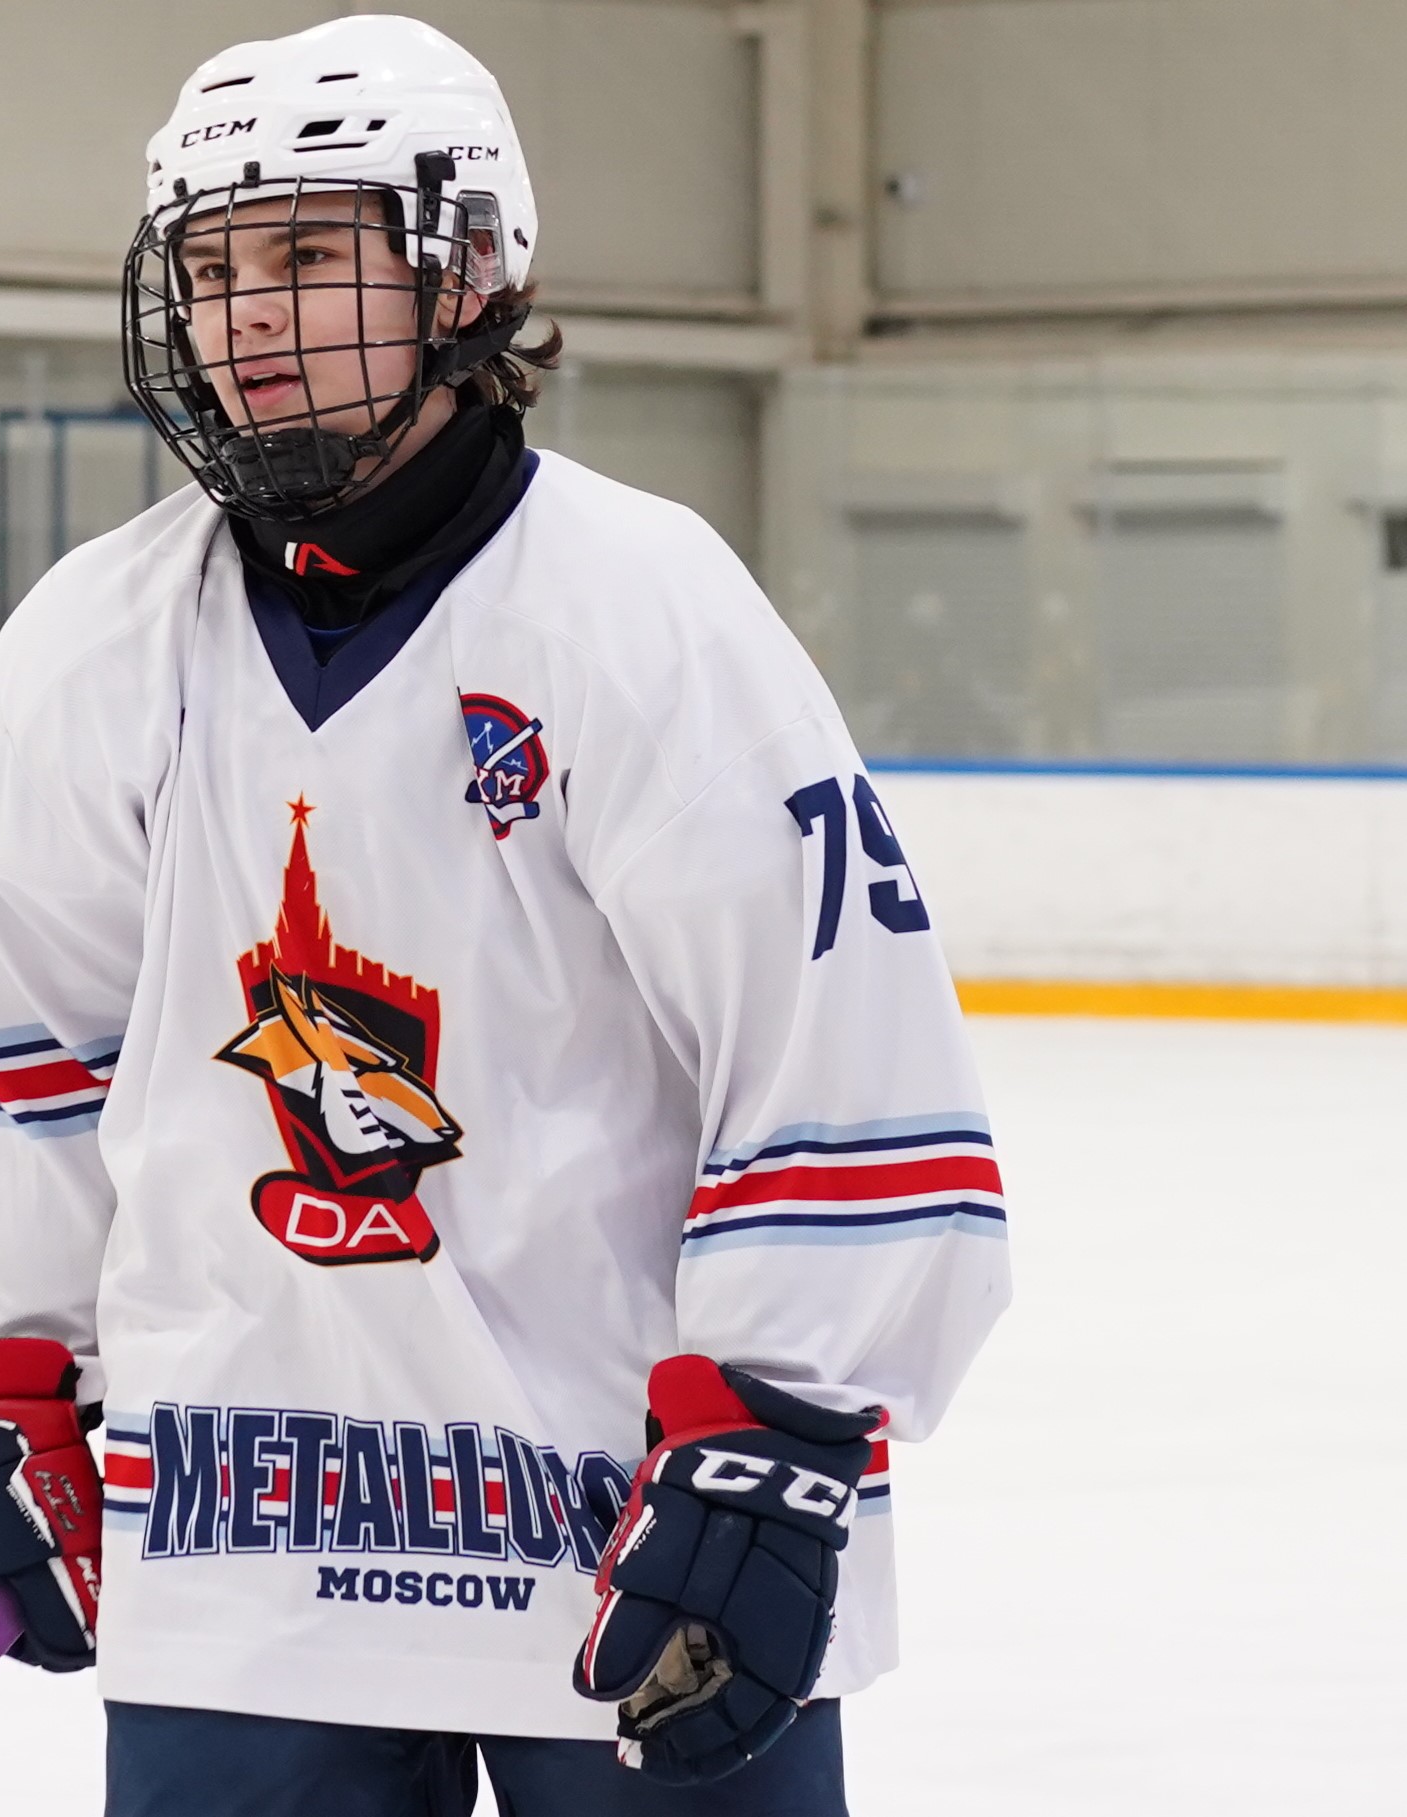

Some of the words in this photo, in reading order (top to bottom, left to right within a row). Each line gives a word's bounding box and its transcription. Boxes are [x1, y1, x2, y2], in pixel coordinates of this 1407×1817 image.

[180, 117, 258, 149] CCM
[447, 146, 499, 161] CCM
[783, 773, 930, 961] 79
[285, 1192, 411, 1248] DA
[316, 1566, 536, 1611] MOSCOW
